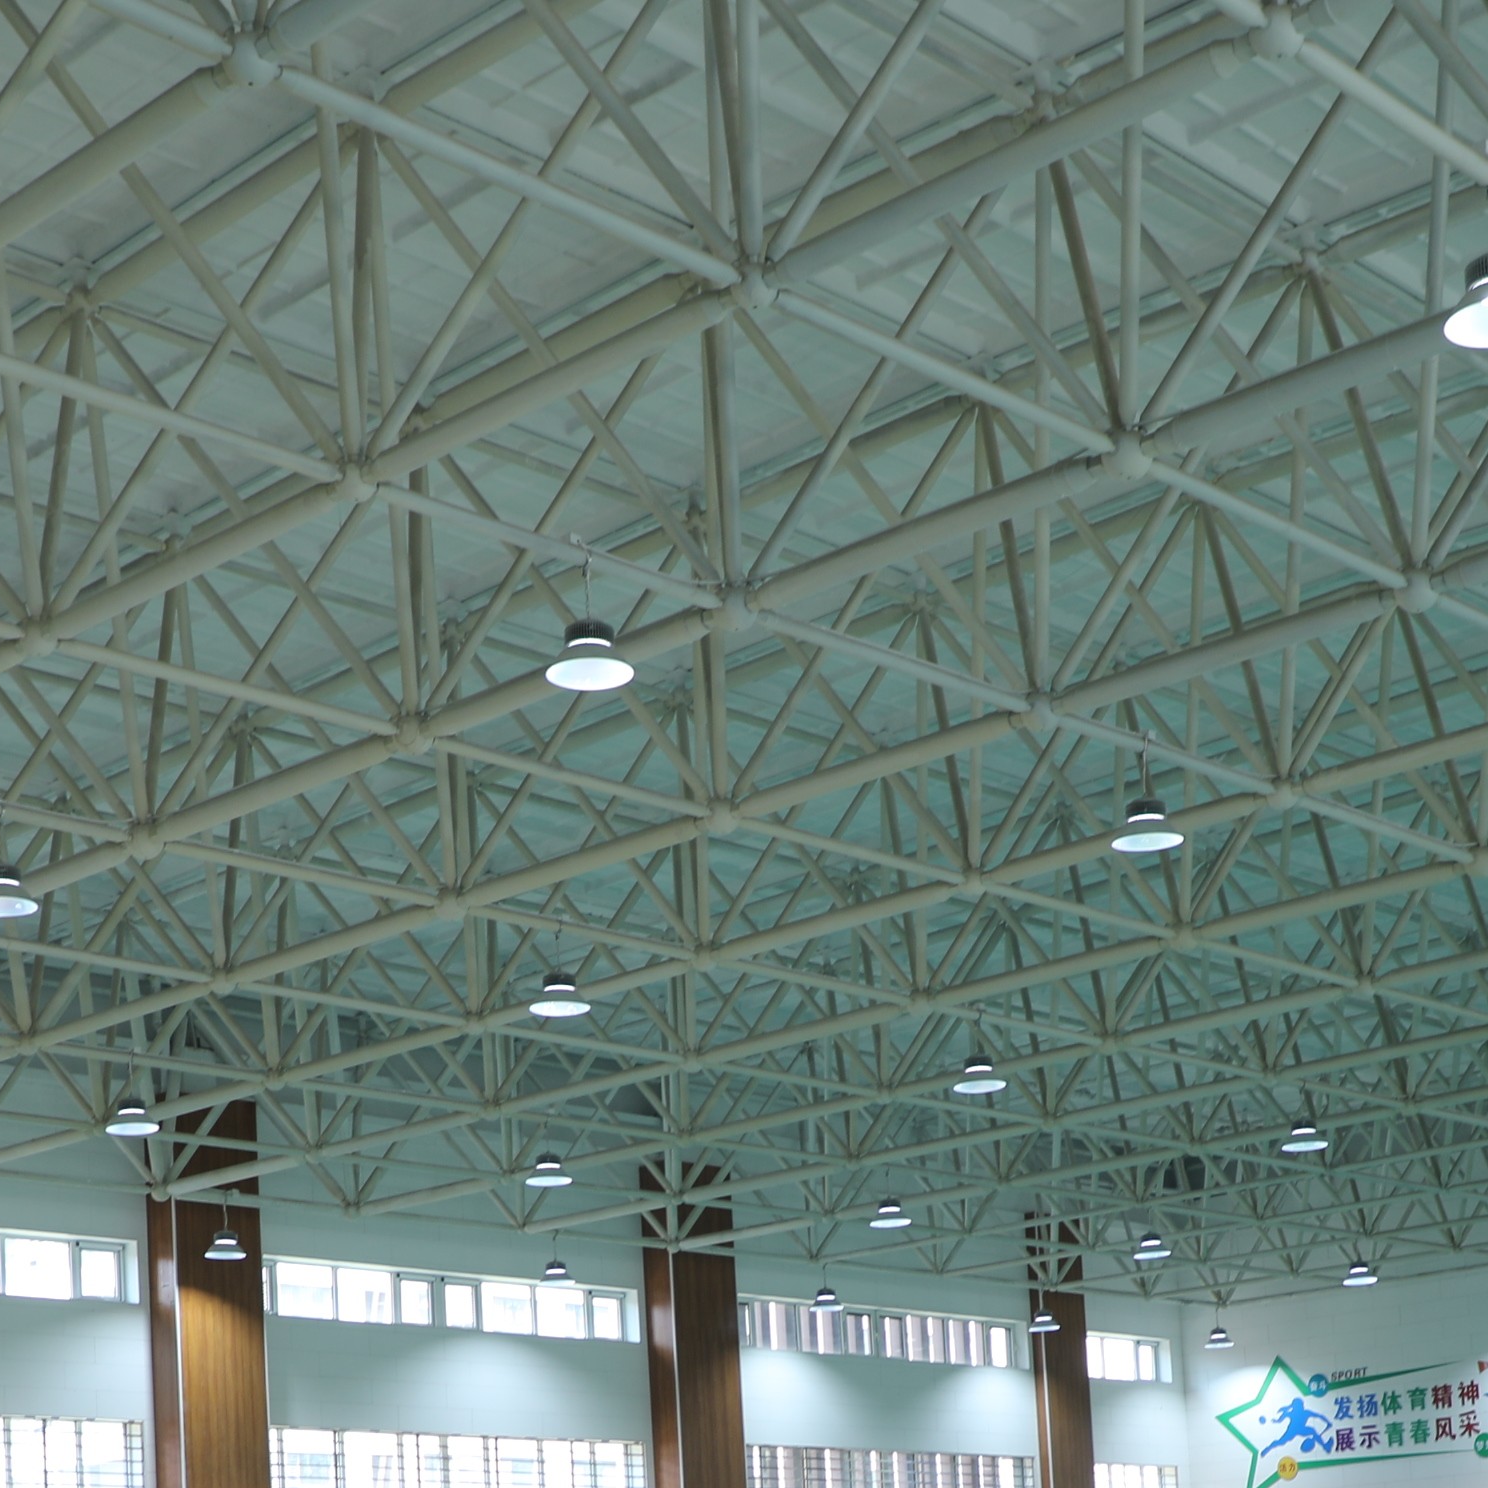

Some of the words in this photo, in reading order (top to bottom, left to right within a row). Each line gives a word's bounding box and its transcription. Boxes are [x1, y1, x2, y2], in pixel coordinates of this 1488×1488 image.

[1331, 1366, 1368, 1382] SPORT
[1333, 1380, 1480, 1420] 发扬体育精神
[1336, 1410, 1481, 1451] 展示青春风采
